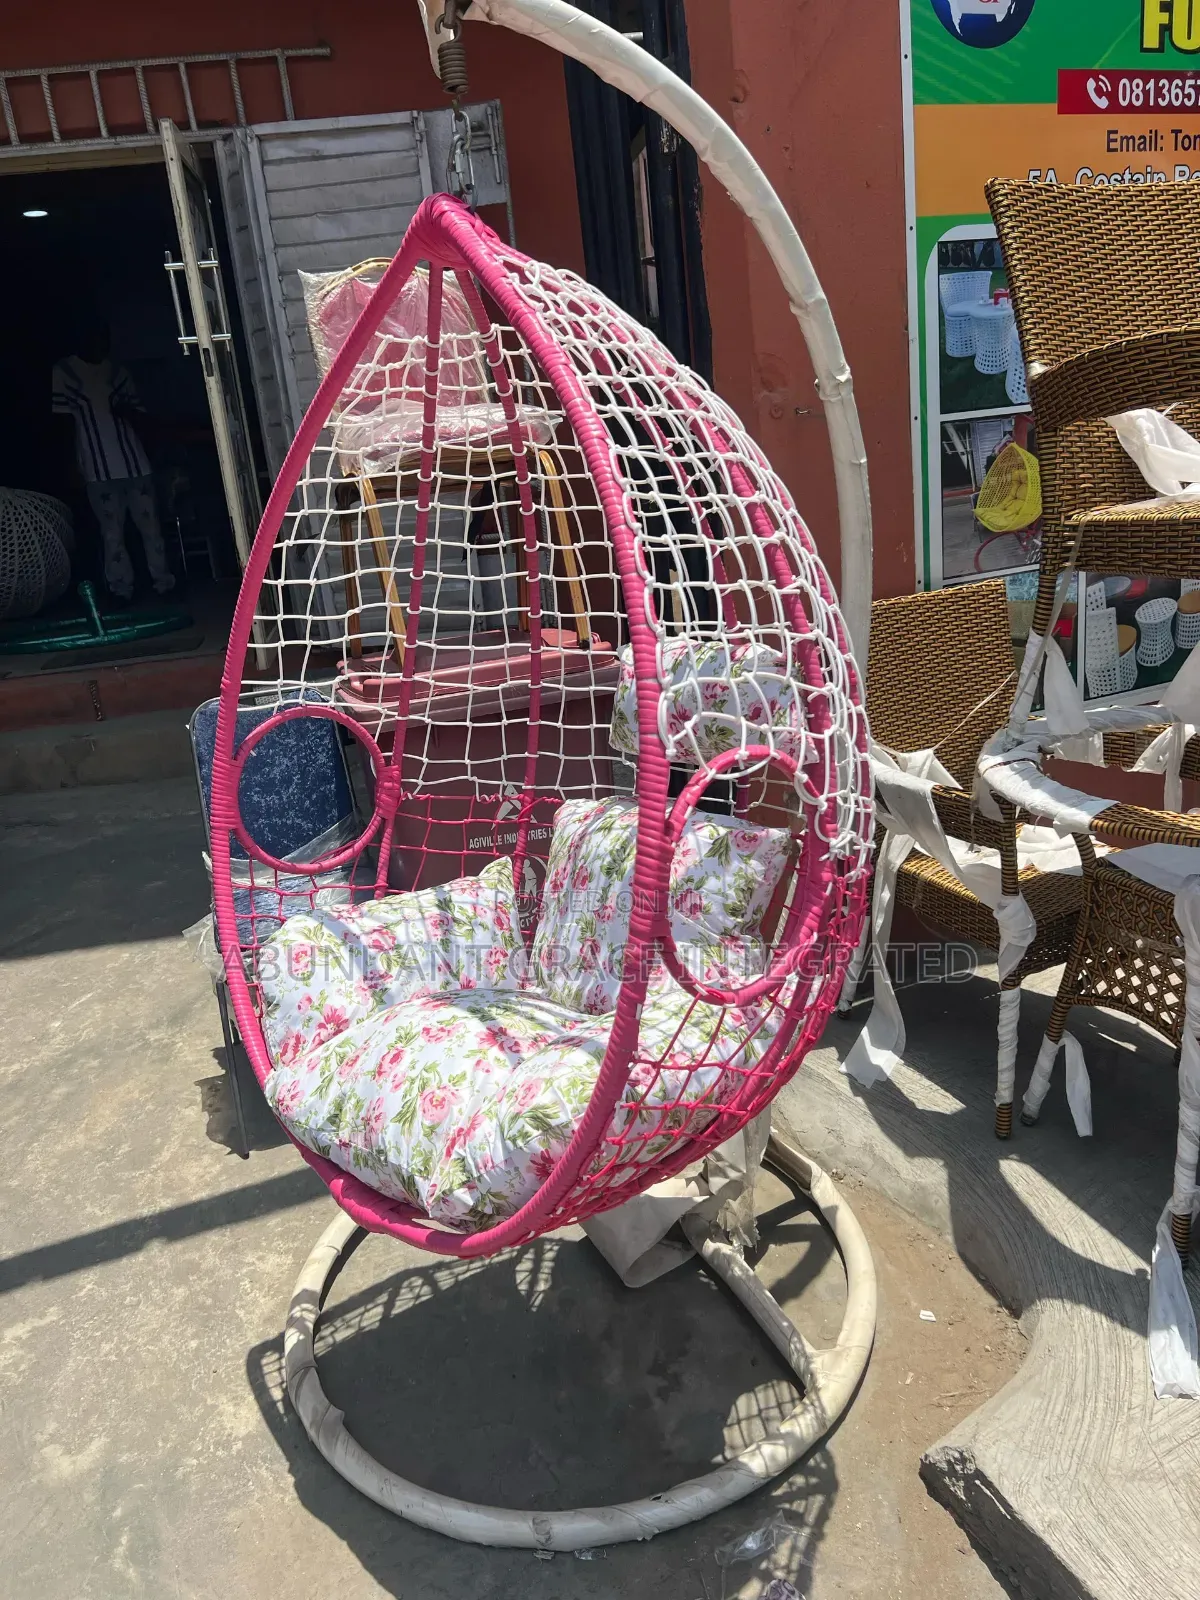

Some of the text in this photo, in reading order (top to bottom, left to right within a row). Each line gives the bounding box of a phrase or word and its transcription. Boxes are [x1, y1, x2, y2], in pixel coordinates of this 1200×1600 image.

[1118, 78, 1200, 107] 081365
[1106, 129, 1164, 153] Email:
[504, 827, 547, 844] INDTRIES
